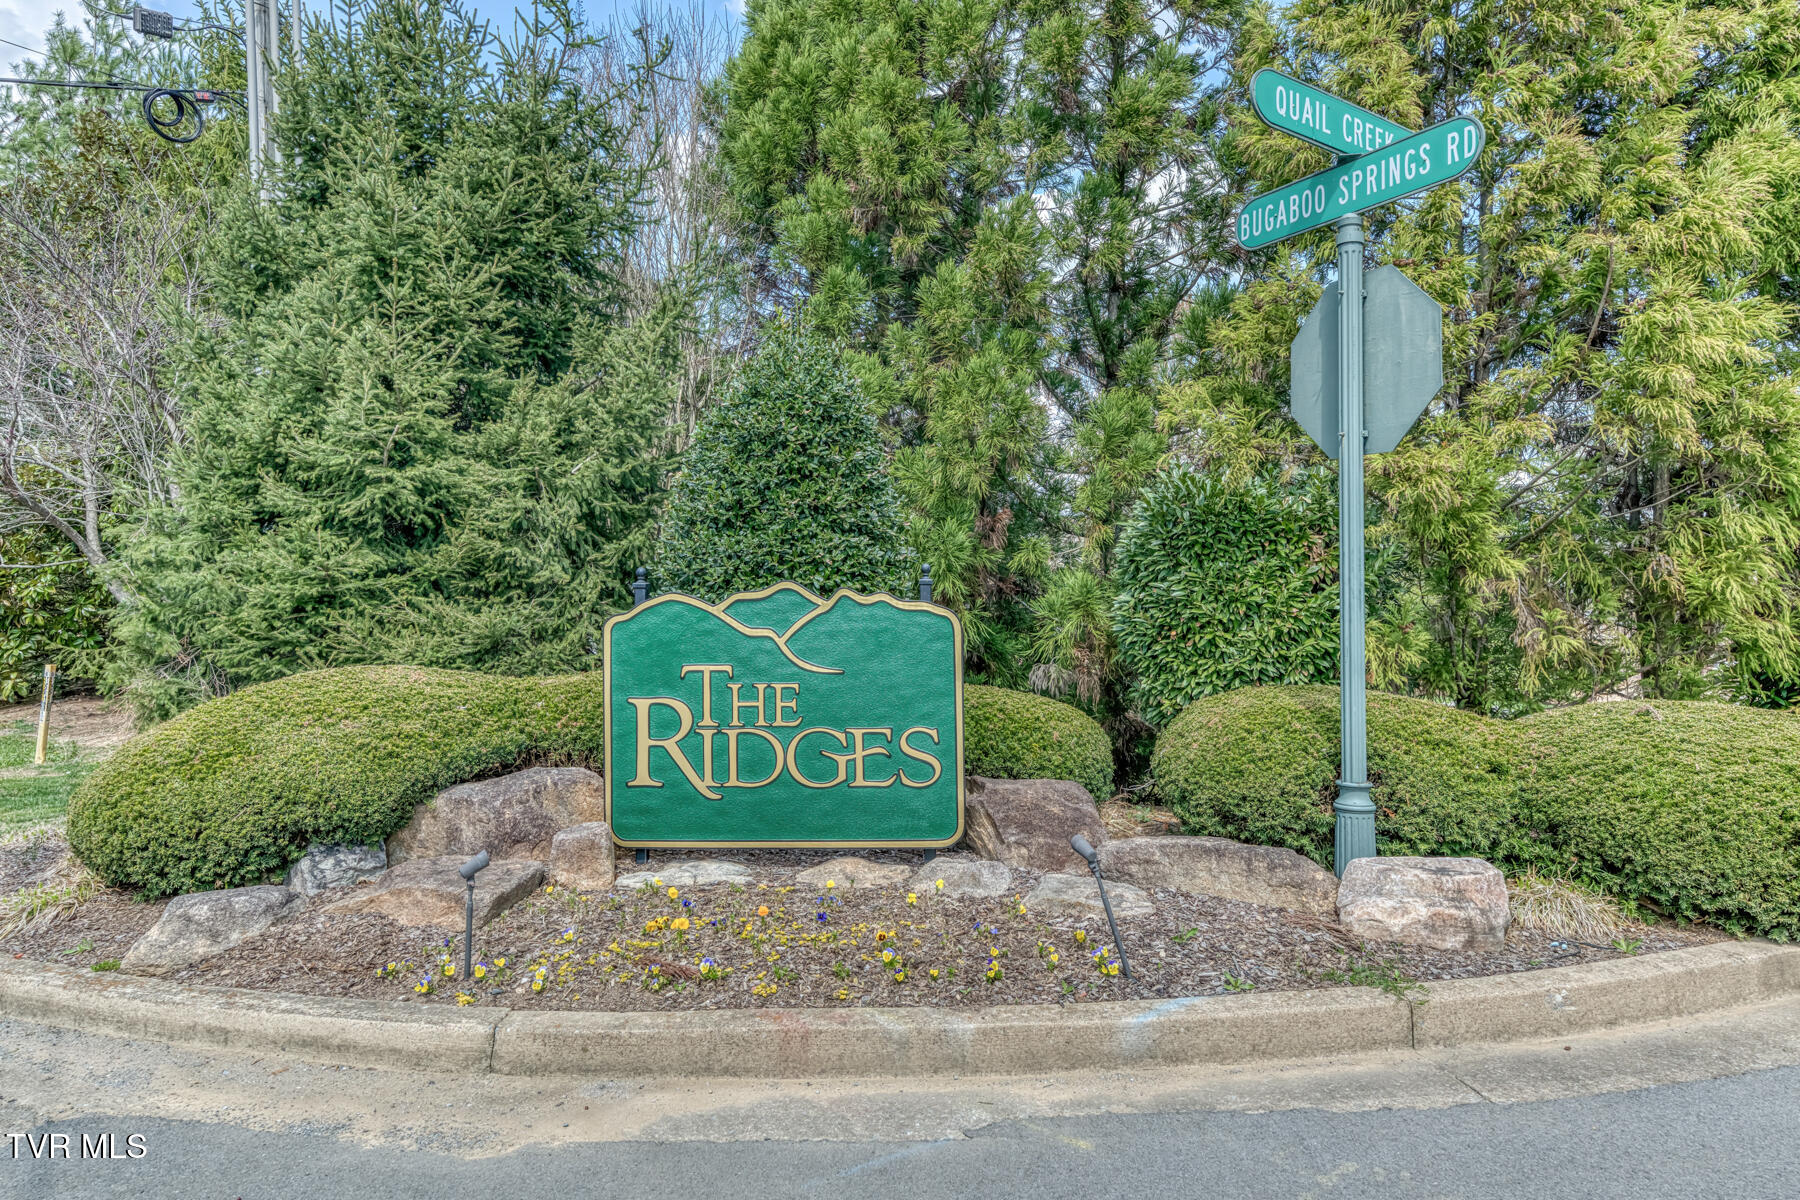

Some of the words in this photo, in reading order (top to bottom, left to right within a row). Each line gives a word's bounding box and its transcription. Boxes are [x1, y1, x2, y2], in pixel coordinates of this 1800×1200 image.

[1275, 86, 1331, 134] QUAIL
[1241, 184, 1326, 241] BUGABOO
[1338, 143, 1431, 205] SPRINGS
[1447, 125, 1476, 165] RD
[680, 664, 803, 727] THE
[626, 696, 943, 800] RIDGES
